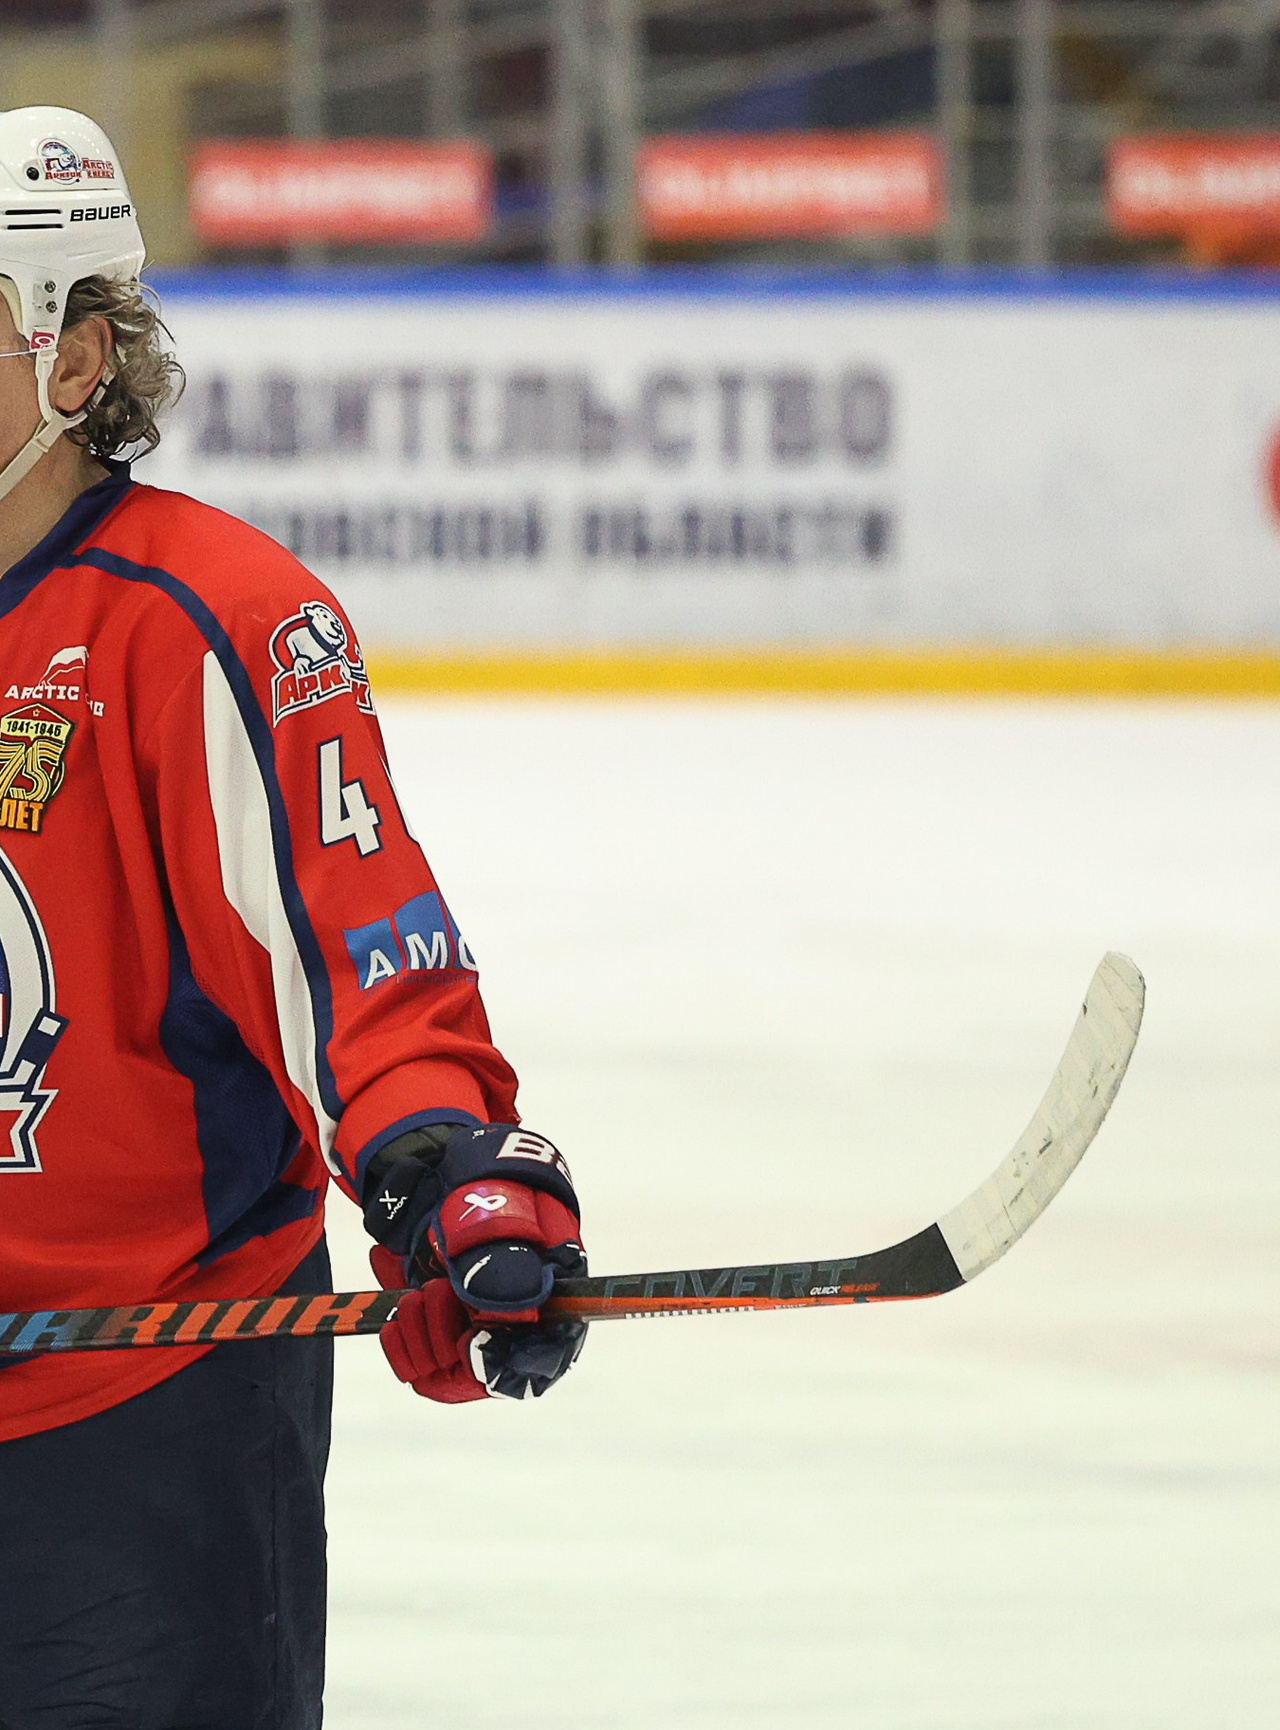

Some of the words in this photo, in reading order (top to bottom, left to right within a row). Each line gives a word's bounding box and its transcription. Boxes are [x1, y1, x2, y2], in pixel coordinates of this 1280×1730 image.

[69, 203, 132, 222] BAUER
[4, 685, 80, 701] ARCTIC
[7, 721, 63, 737] 1941-1945
[317, 735, 405, 858] 4
[603, 1258, 858, 1299] COVERT
